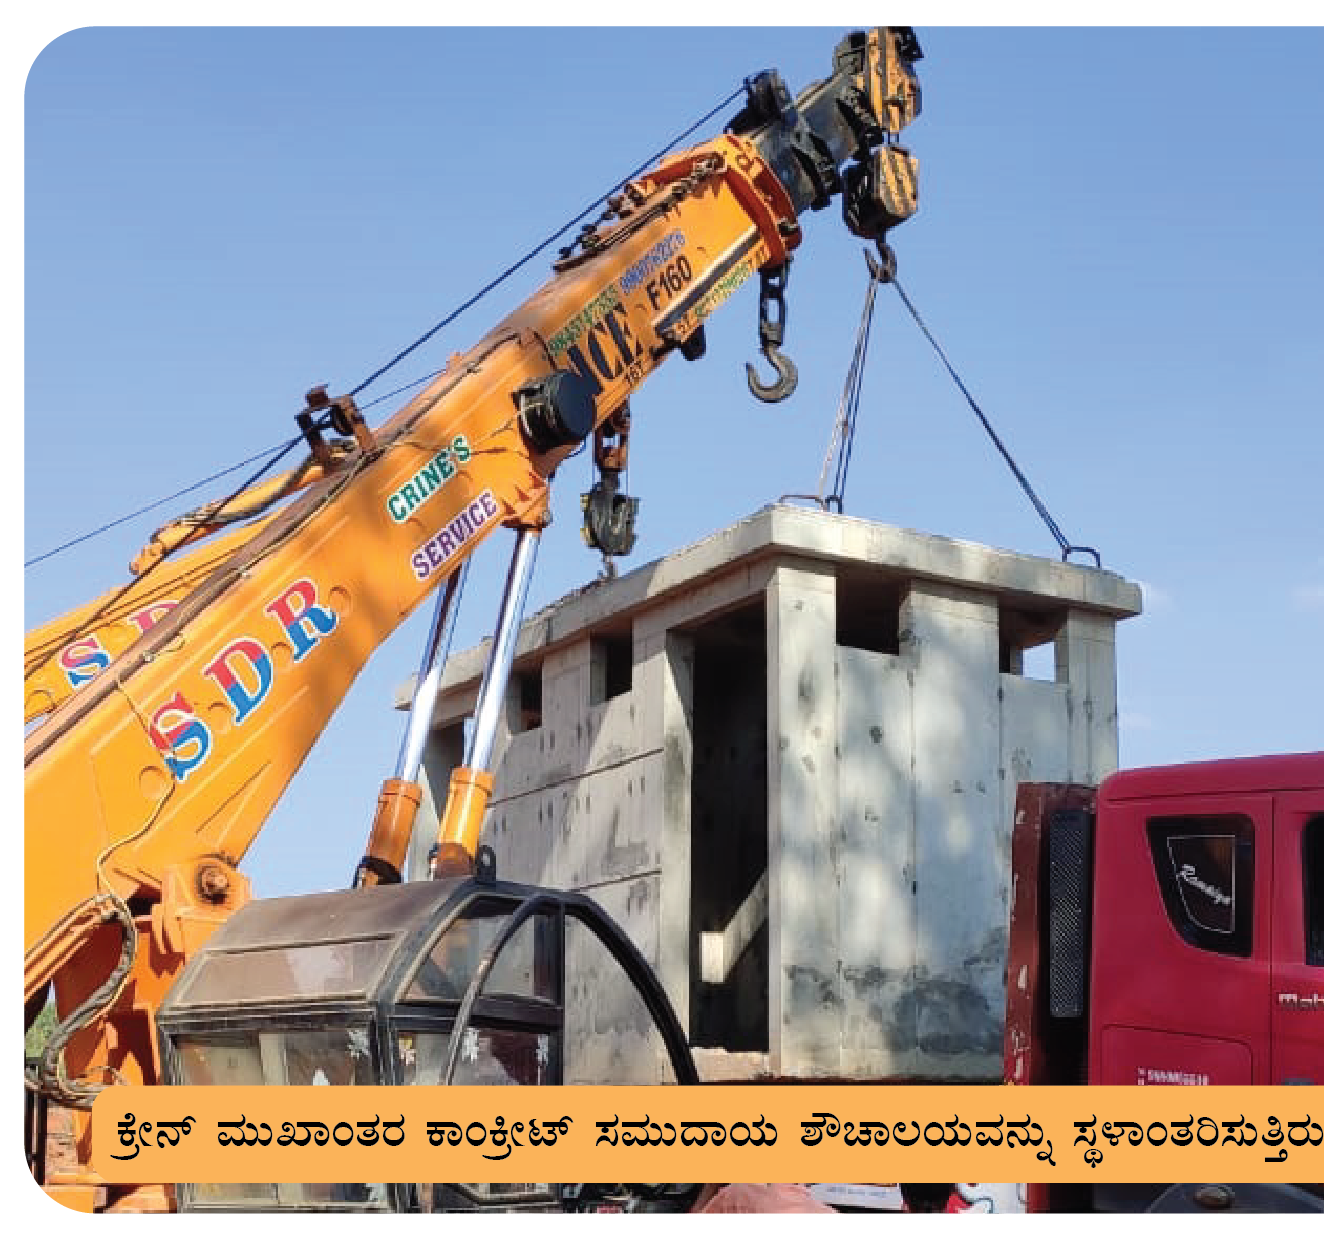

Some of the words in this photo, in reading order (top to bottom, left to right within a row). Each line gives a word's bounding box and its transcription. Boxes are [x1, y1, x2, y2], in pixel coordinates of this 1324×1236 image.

[646, 254, 693, 310] F160
[387, 435, 472, 524] CRINE'S
[411, 491, 498, 580] SERVICE
